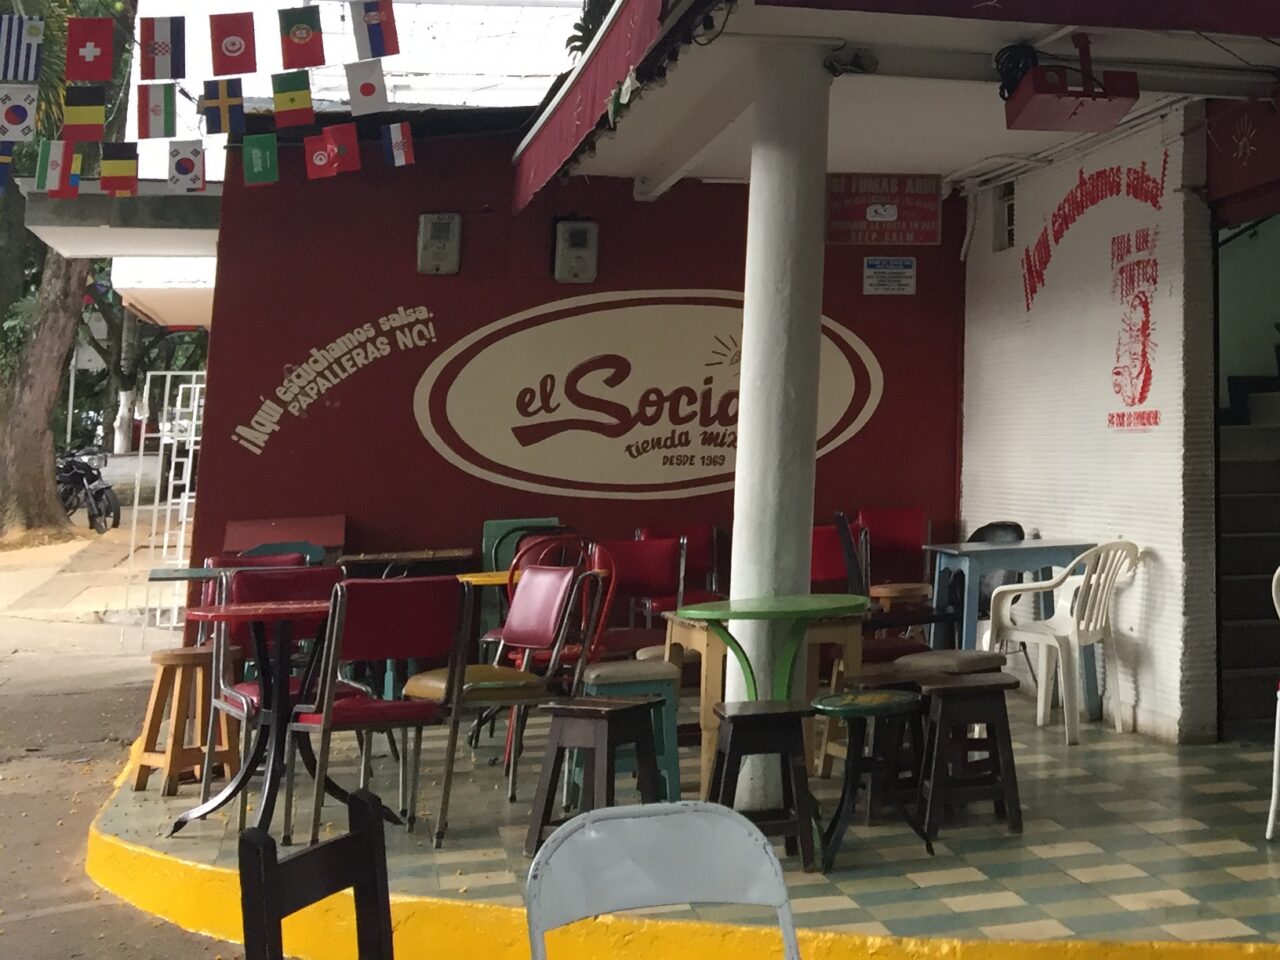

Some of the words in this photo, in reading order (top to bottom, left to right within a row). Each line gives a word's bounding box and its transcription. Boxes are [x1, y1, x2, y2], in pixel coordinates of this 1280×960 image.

[231, 395, 284, 456] ¡Aquí
[275, 323, 376, 402] escuchamos
[287, 336, 391, 417] PAPALLERAS
[395, 321, 437, 351] NO!
[510, 353, 739, 448] Socia
[515, 373, 561, 418] el
[624, 429, 692, 459] tienda
[662, 454, 695, 466] DESDE
